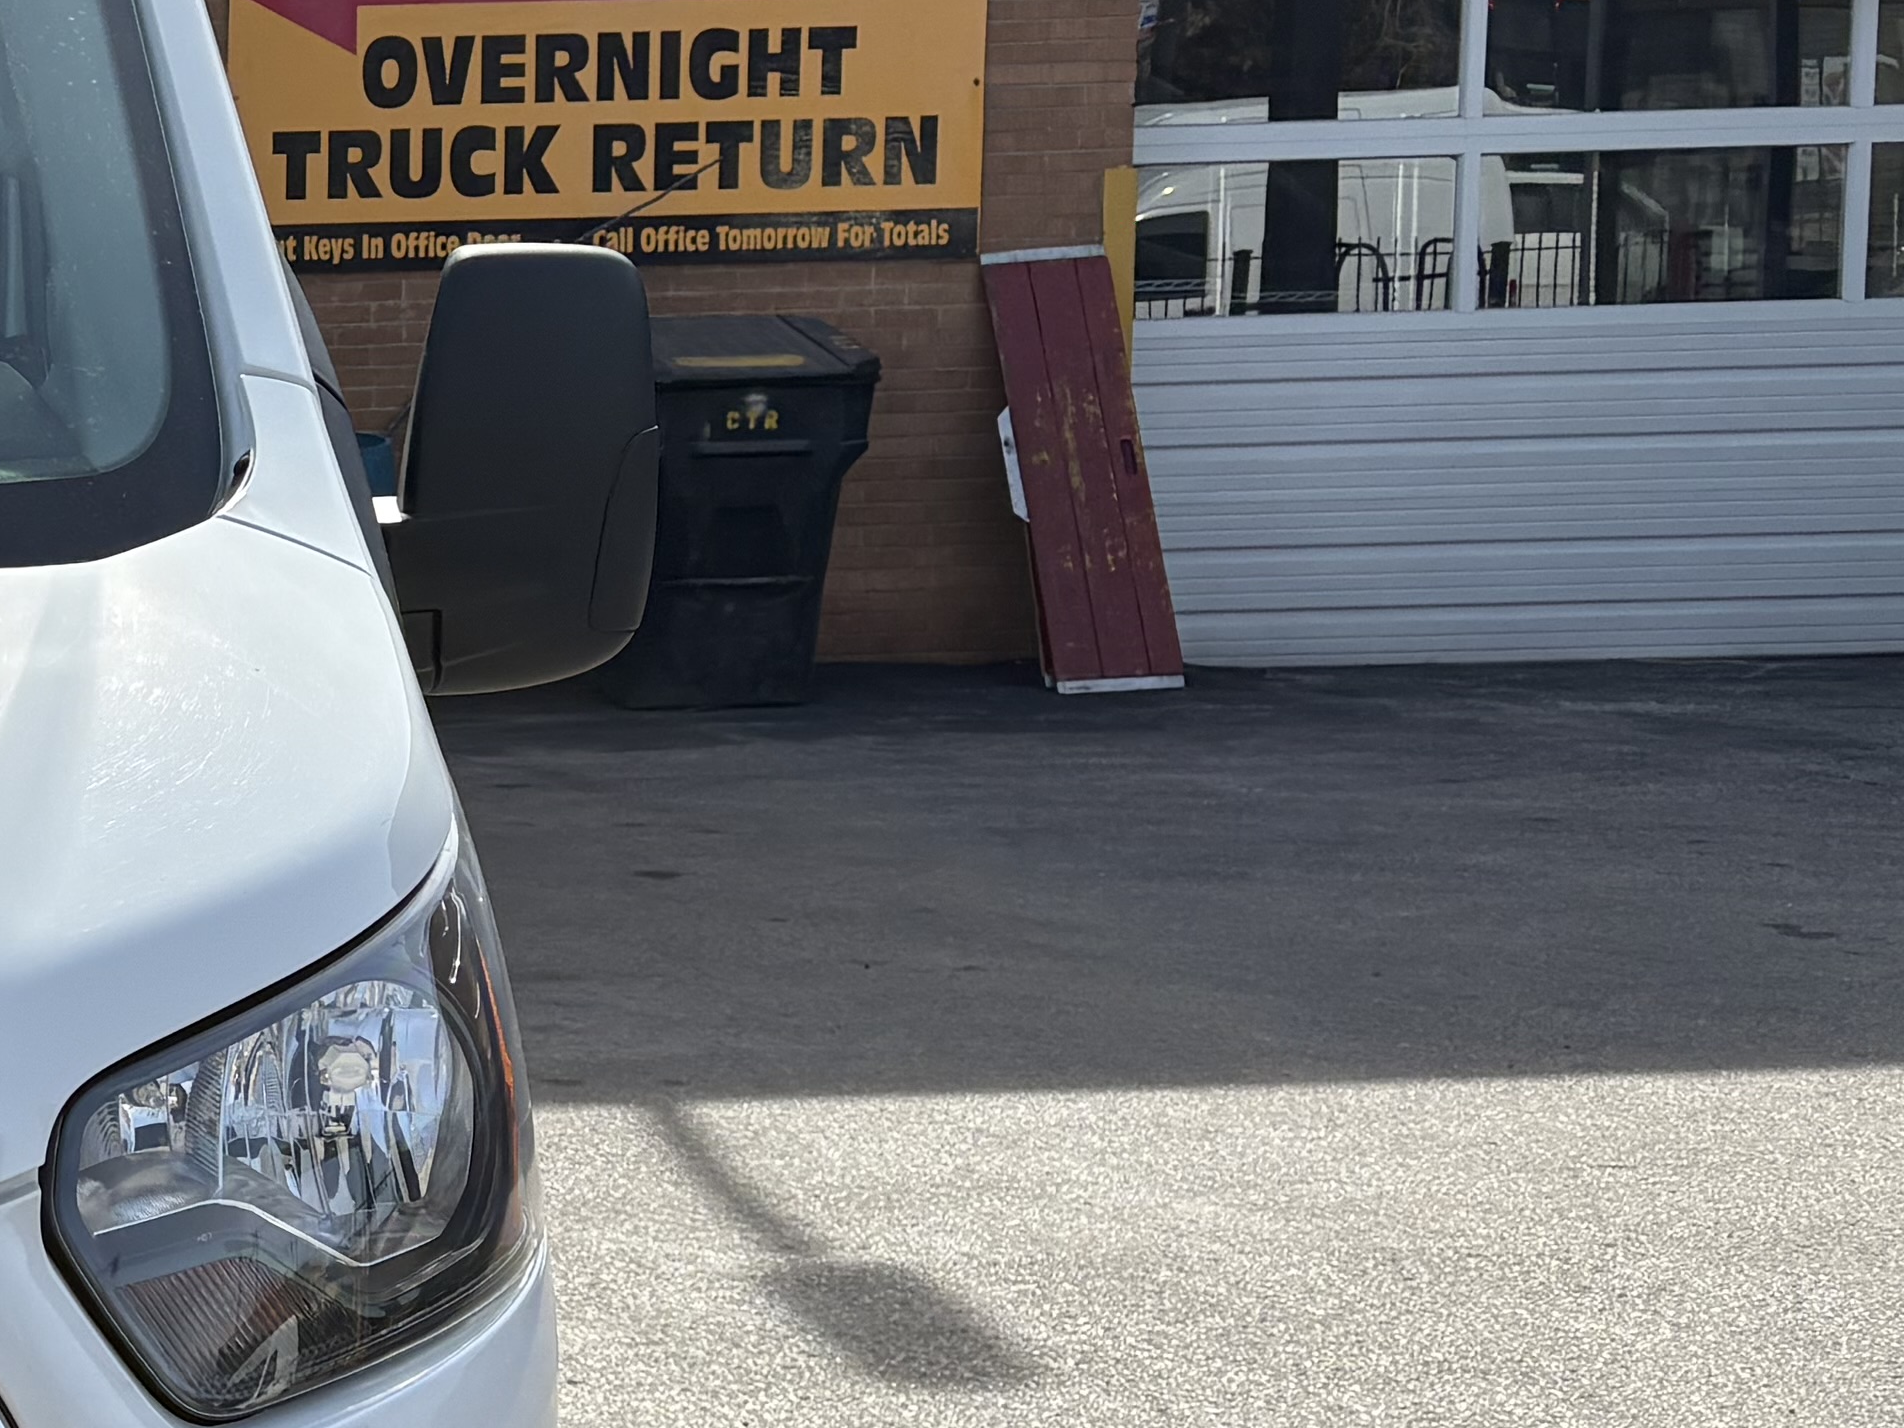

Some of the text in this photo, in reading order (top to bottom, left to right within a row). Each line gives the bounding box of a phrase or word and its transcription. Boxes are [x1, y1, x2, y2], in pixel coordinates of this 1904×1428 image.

[361, 25, 858, 109] OVERNIGHT
[272, 113, 940, 201] TRUCK RETURN
[304, 234, 355, 265] Keys
[362, 233, 384, 260] In
[391, 230, 460, 259] Office
[592, 226, 634, 254] Call
[640, 225, 710, 254] Office
[716, 223, 831, 252] Tomorrow
[837, 221, 877, 249] For
[880, 219, 950, 246] Totals
